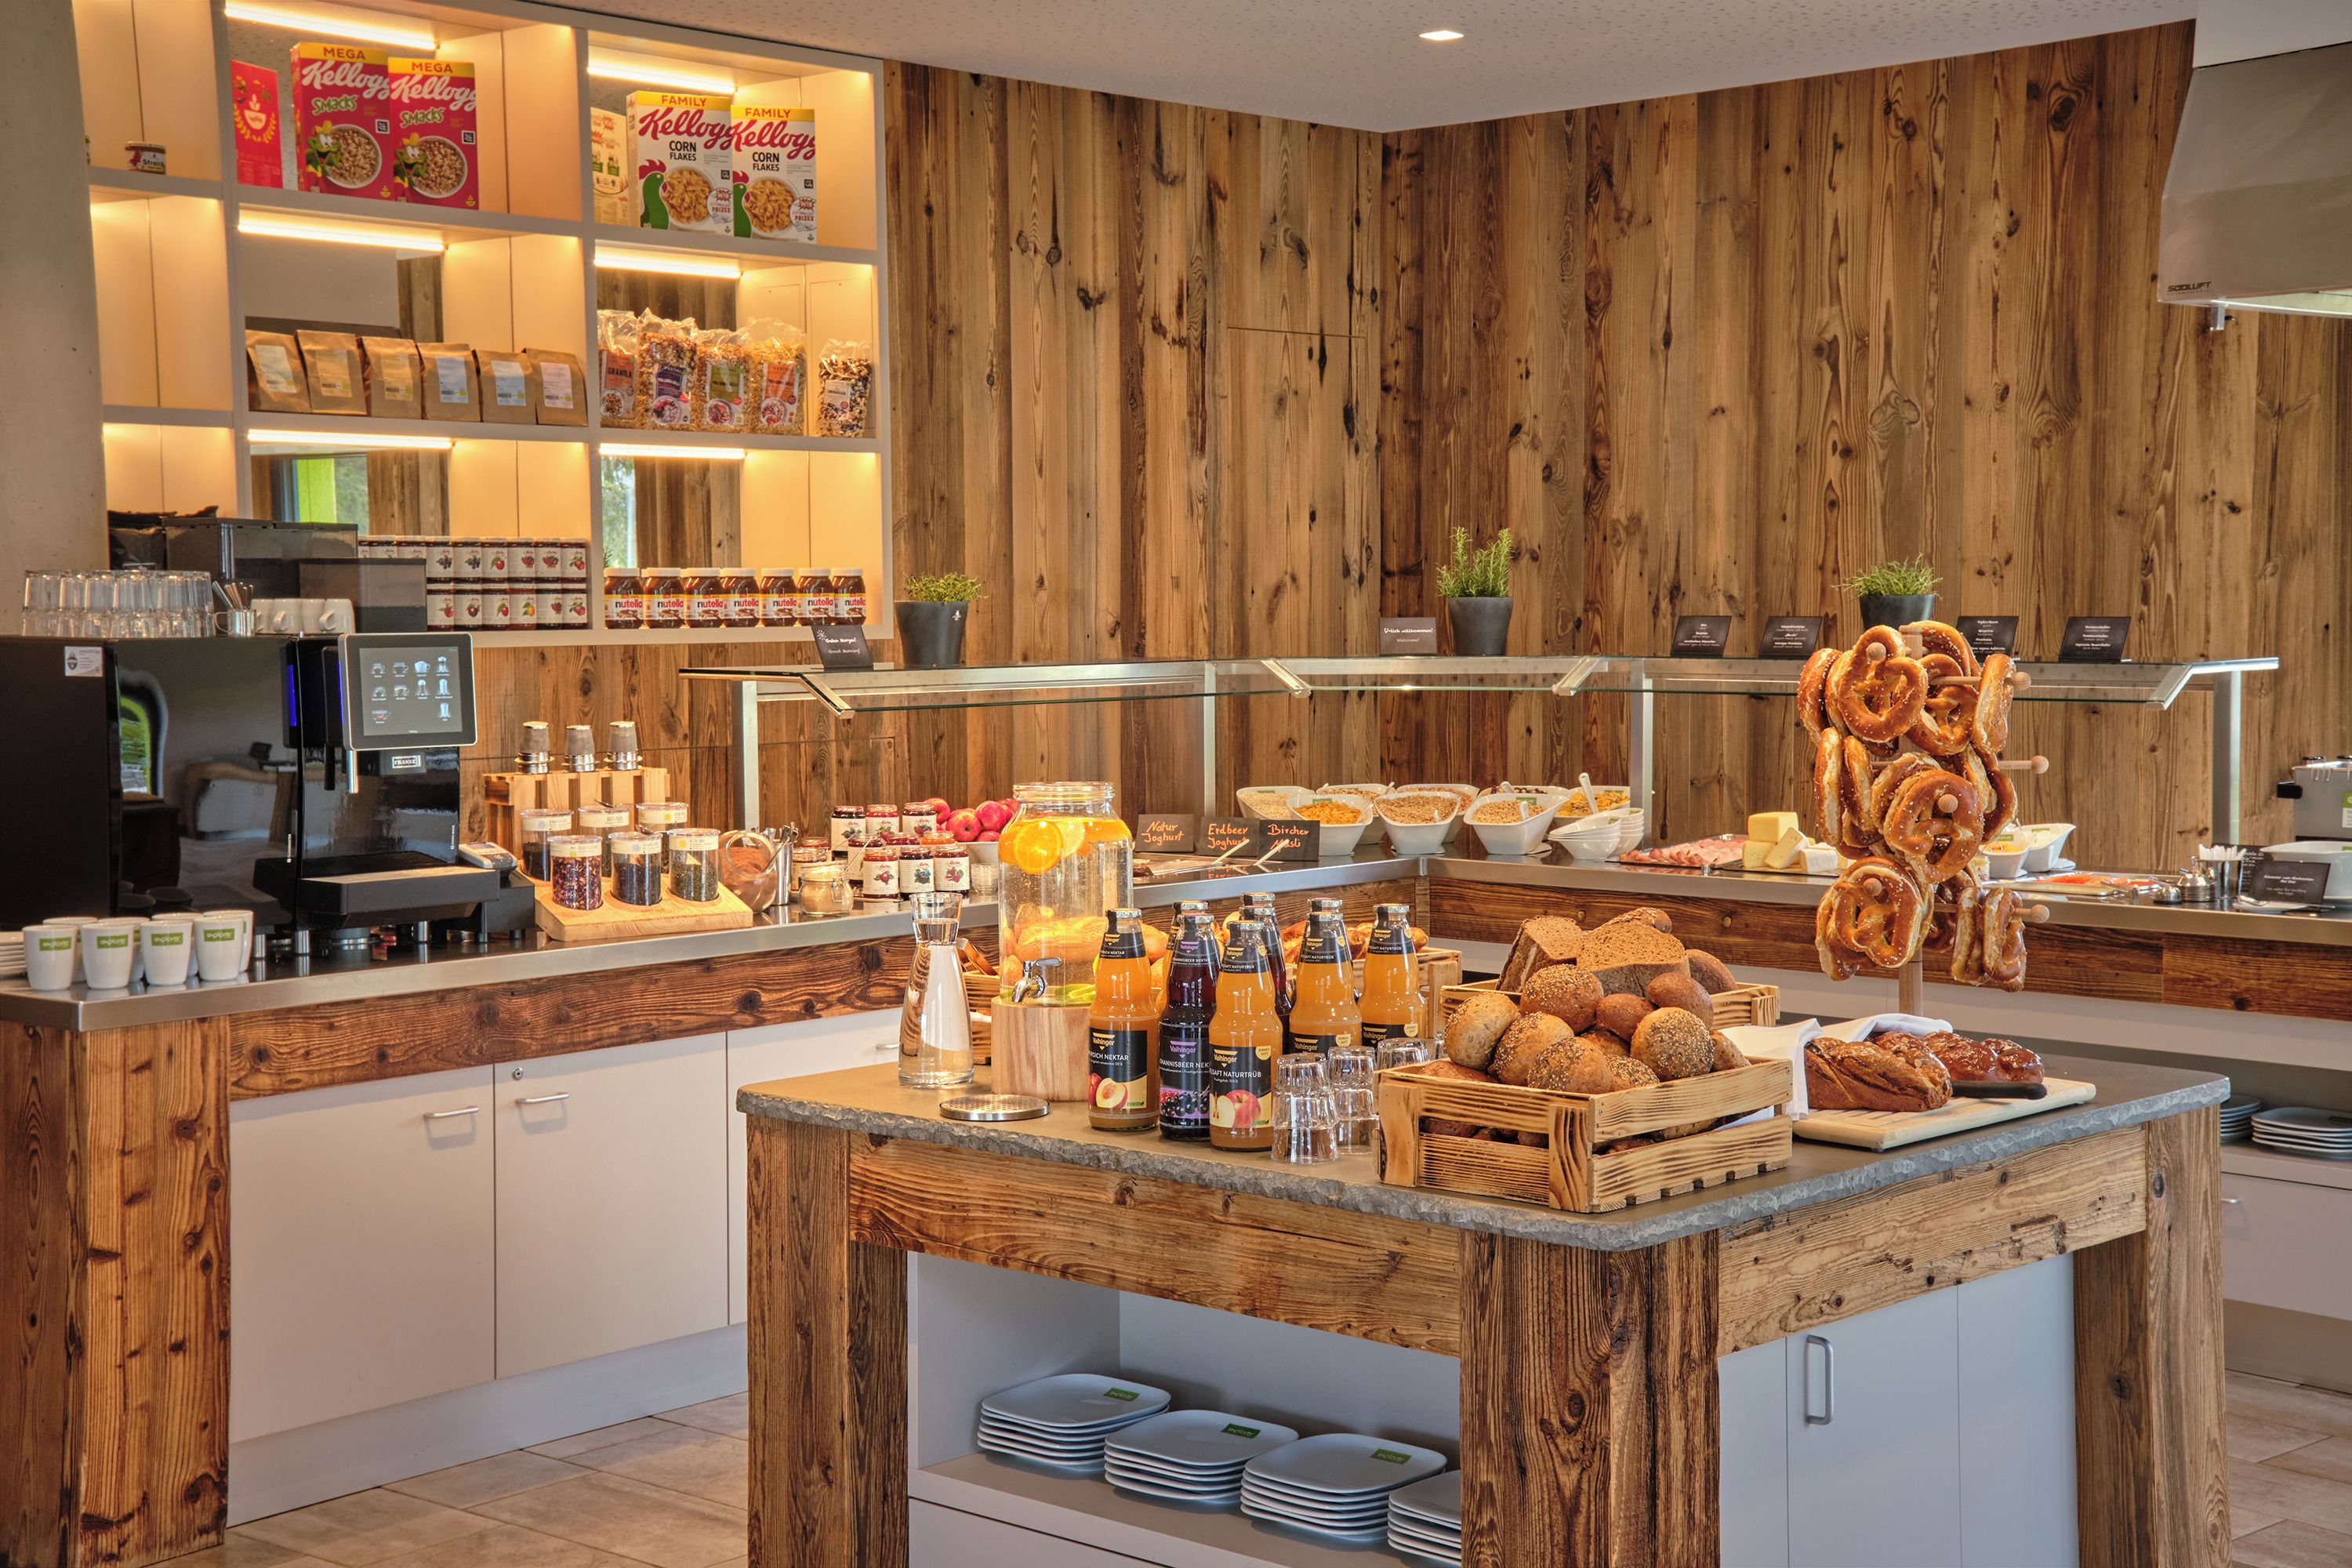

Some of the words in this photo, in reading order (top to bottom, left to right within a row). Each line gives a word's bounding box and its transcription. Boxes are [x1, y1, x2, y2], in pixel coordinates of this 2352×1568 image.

[323, 47, 365, 60] MEGA
[412, 63, 453, 73] MEGA
[662, 95, 708, 107] FAMILY
[746, 107, 791, 118] FAMILY
[669, 140, 696, 152] CORN
[670, 152, 696, 162] FLAKES
[753, 152, 779, 162] CORN
[753, 163, 779, 172] FLAKES
[615, 599, 643, 608] nutella
[657, 599, 684, 608] nutella
[698, 599, 724, 608] nutella
[734, 598, 759, 607] nutella
[773, 597, 797, 607] nutella
[808, 597, 833, 606] nutella
[1147, 821, 1178, 833] Natur
[1208, 823, 1248, 835] Erdbeer
[1268, 824, 1308, 836] Bircher
[1142, 832, 1184, 845] Joghurt
[1363, 1031, 1387, 1041] Vaihinger
[1093, 1036, 1115, 1047] Vaihinger
[1170, 1045, 1196, 1054] Vaihinger
[1294, 1042, 1318, 1052] Vaihinger
[1160, 1058, 1194, 1068] OHANNISBEER
[1214, 1054, 1238, 1064] Vaihinger
